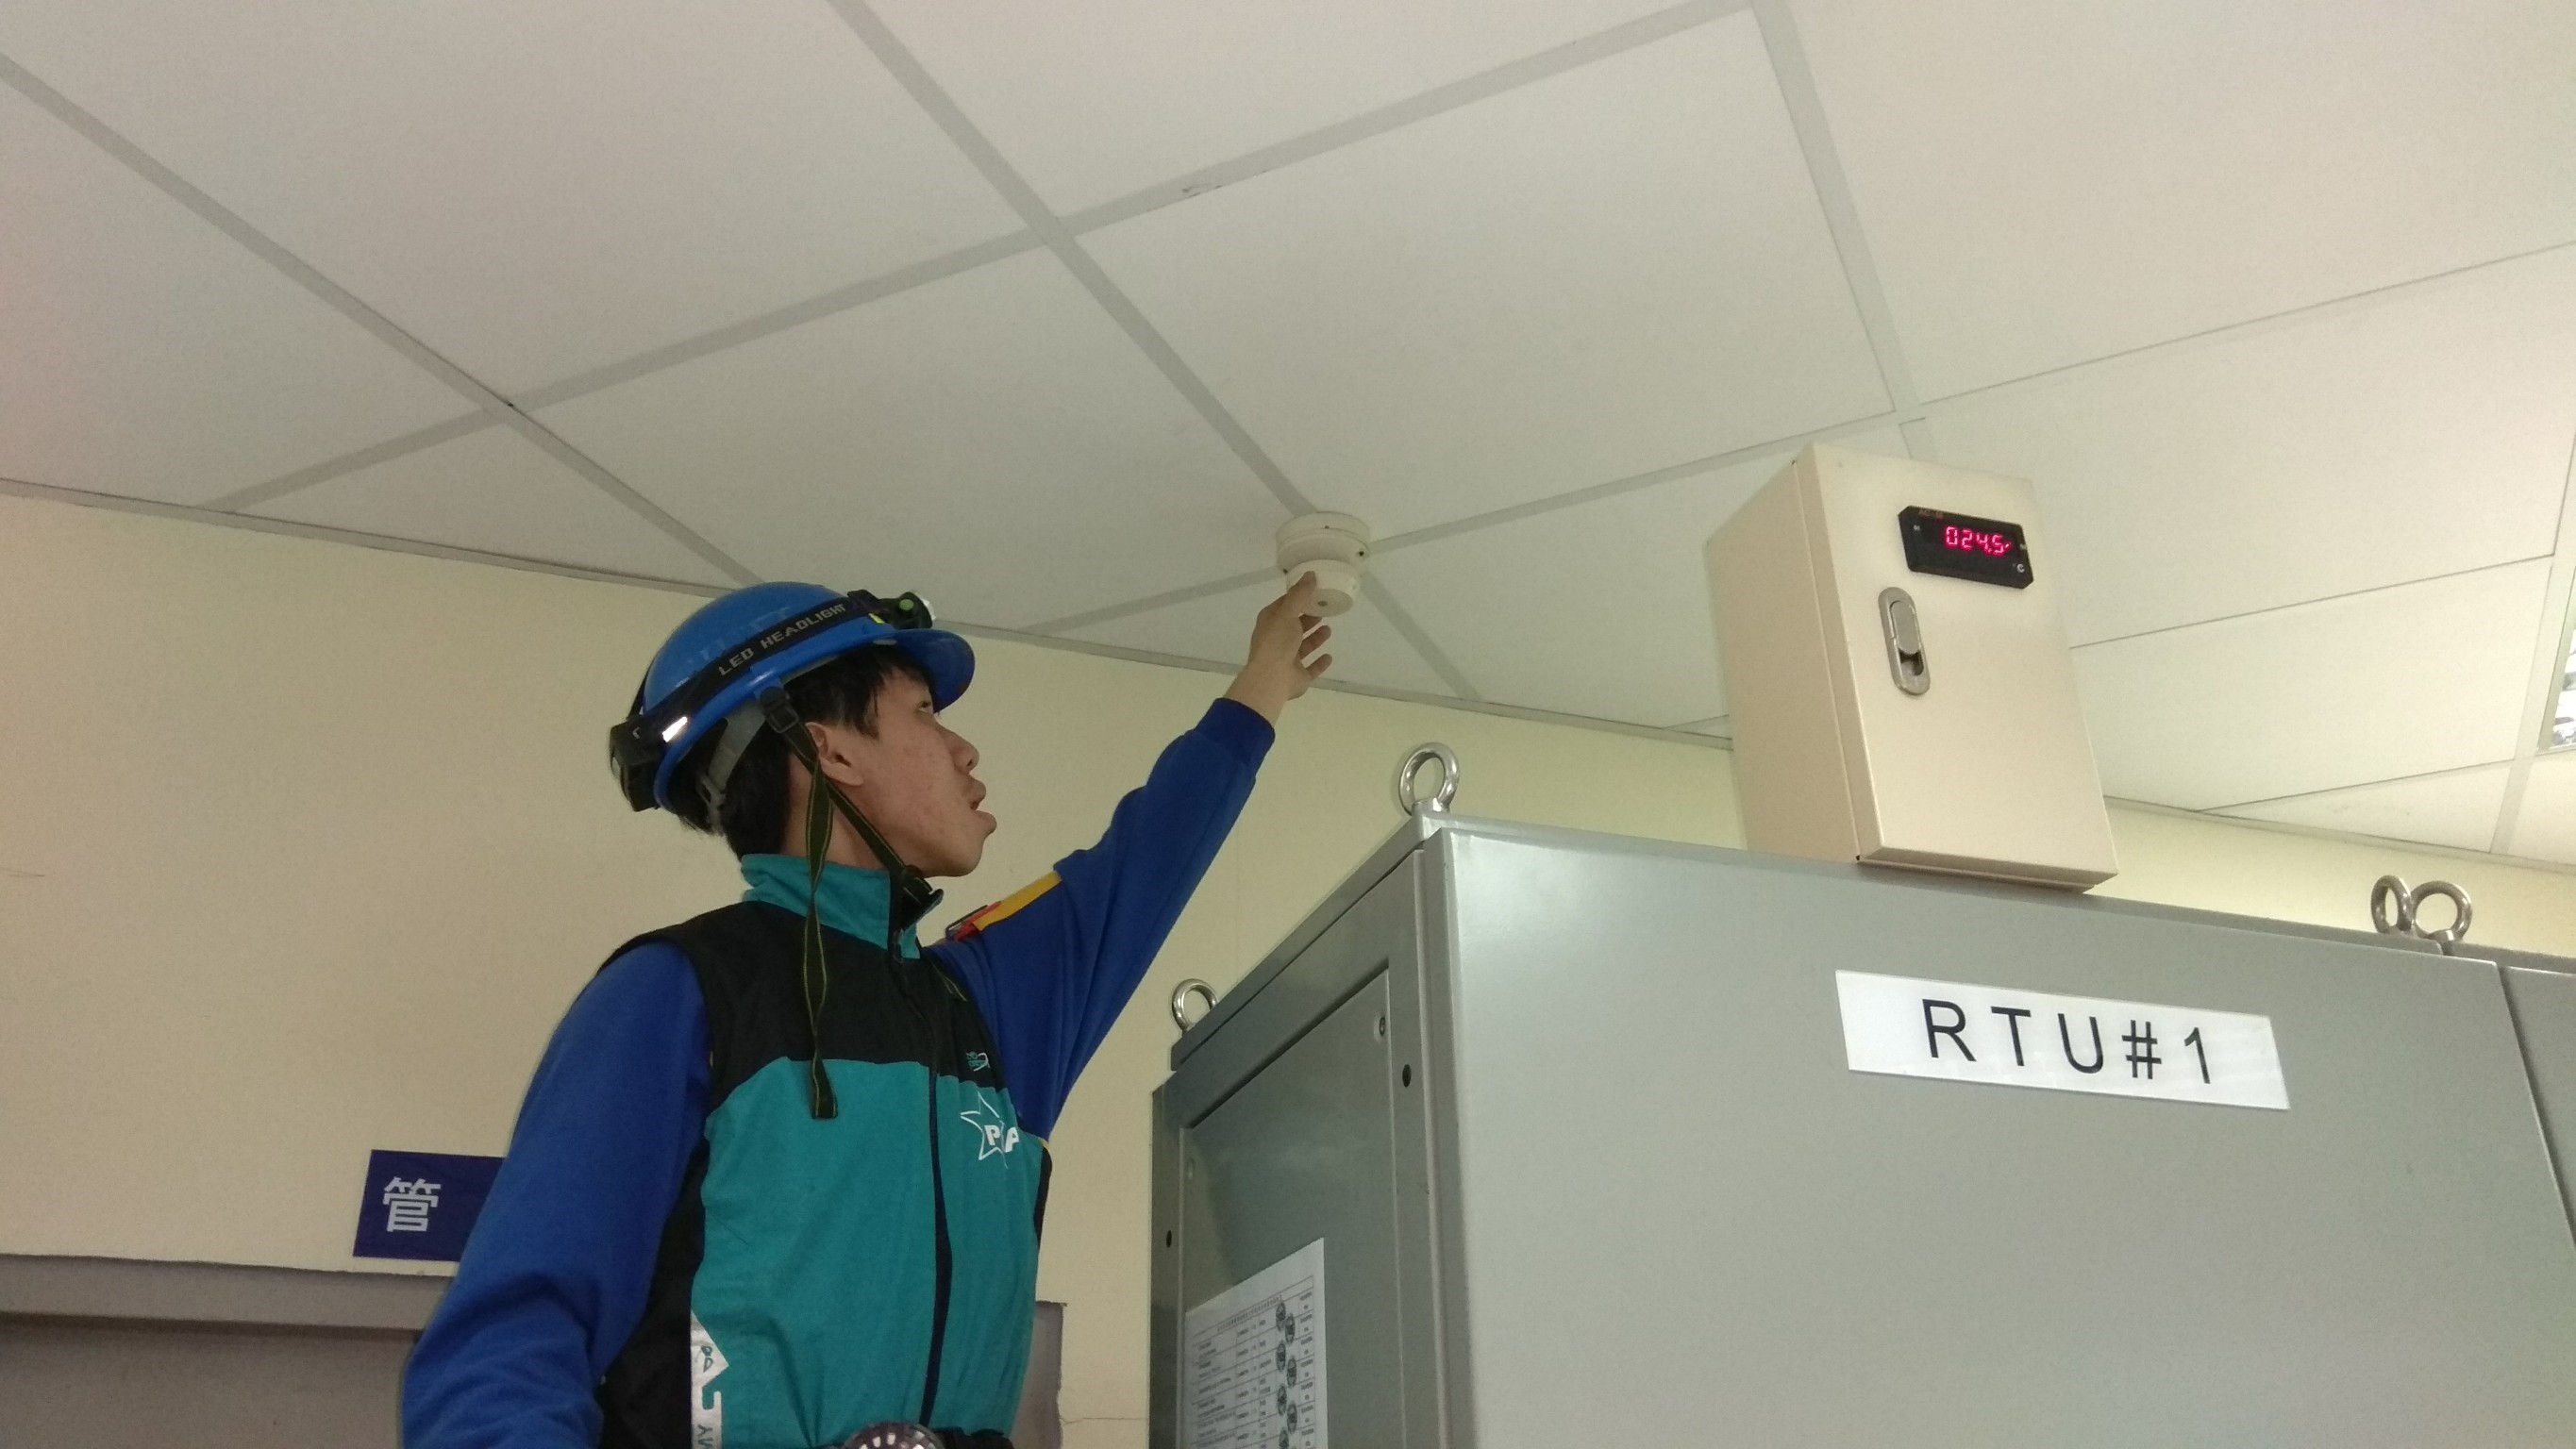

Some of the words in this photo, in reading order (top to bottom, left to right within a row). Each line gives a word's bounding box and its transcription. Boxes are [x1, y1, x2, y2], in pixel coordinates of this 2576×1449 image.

[717, 647, 755, 676] LED
[760, 604, 846, 649] HEADLIGHT
[382, 1176, 442, 1233] 管
